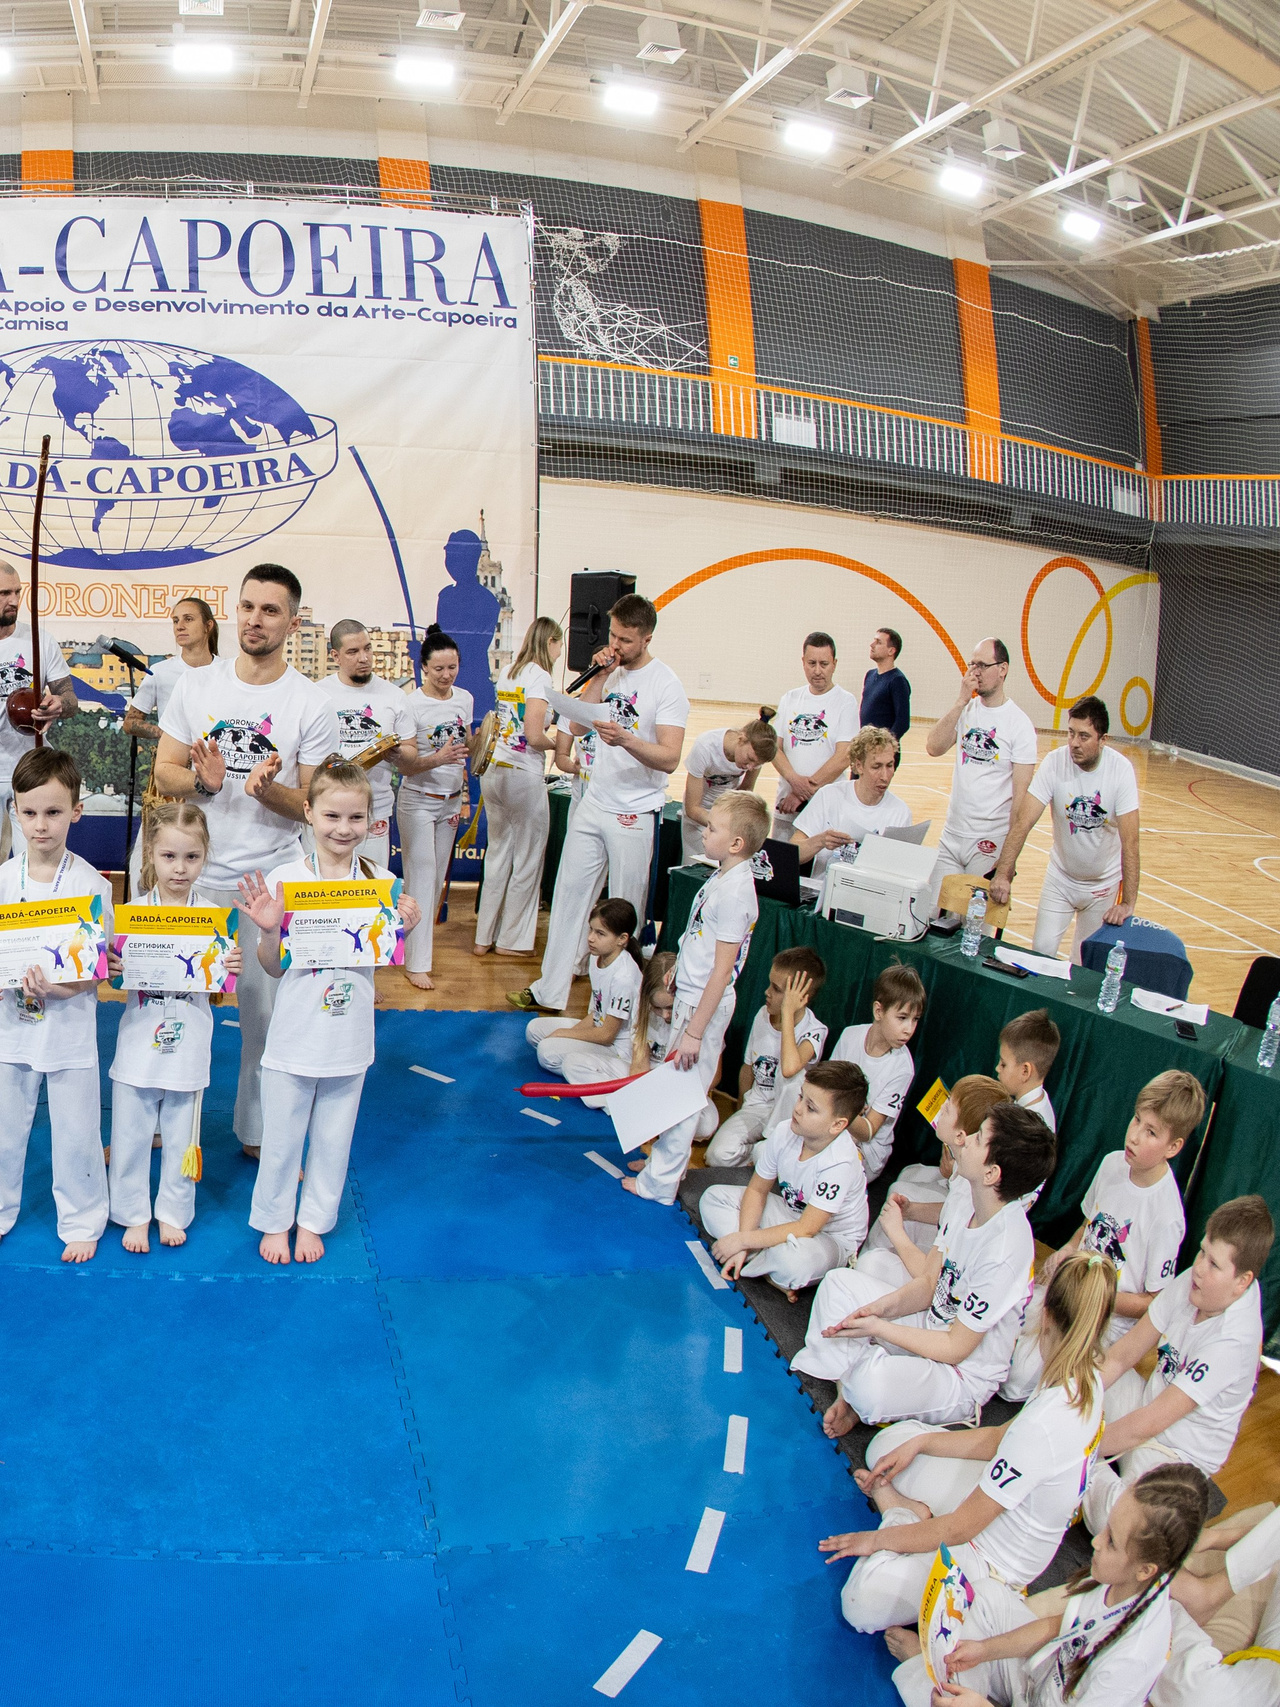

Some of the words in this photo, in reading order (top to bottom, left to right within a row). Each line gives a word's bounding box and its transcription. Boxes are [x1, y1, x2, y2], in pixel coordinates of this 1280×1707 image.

[72, 300, 88, 312] e
[95, 297, 310, 317] Desenvolvimento
[316, 301, 348, 318] da
[352, 304, 518, 329] Arte-Capoeira
[224, 719, 264, 731] VORONEZH
[294, 889, 378, 899] ABADÁ-CAPOEIRA
[129, 914, 213, 924] ABADÁ-CAPOEIRA
[294, 918, 341, 926] СЕРТИФИКАТ
[610, 996, 630, 1012] 112
[816, 1181, 840, 1201] 93
[964, 1291, 989, 1320] 52
[1185, 1358, 1209, 1383] 46
[989, 1458, 1022, 1489] 67
